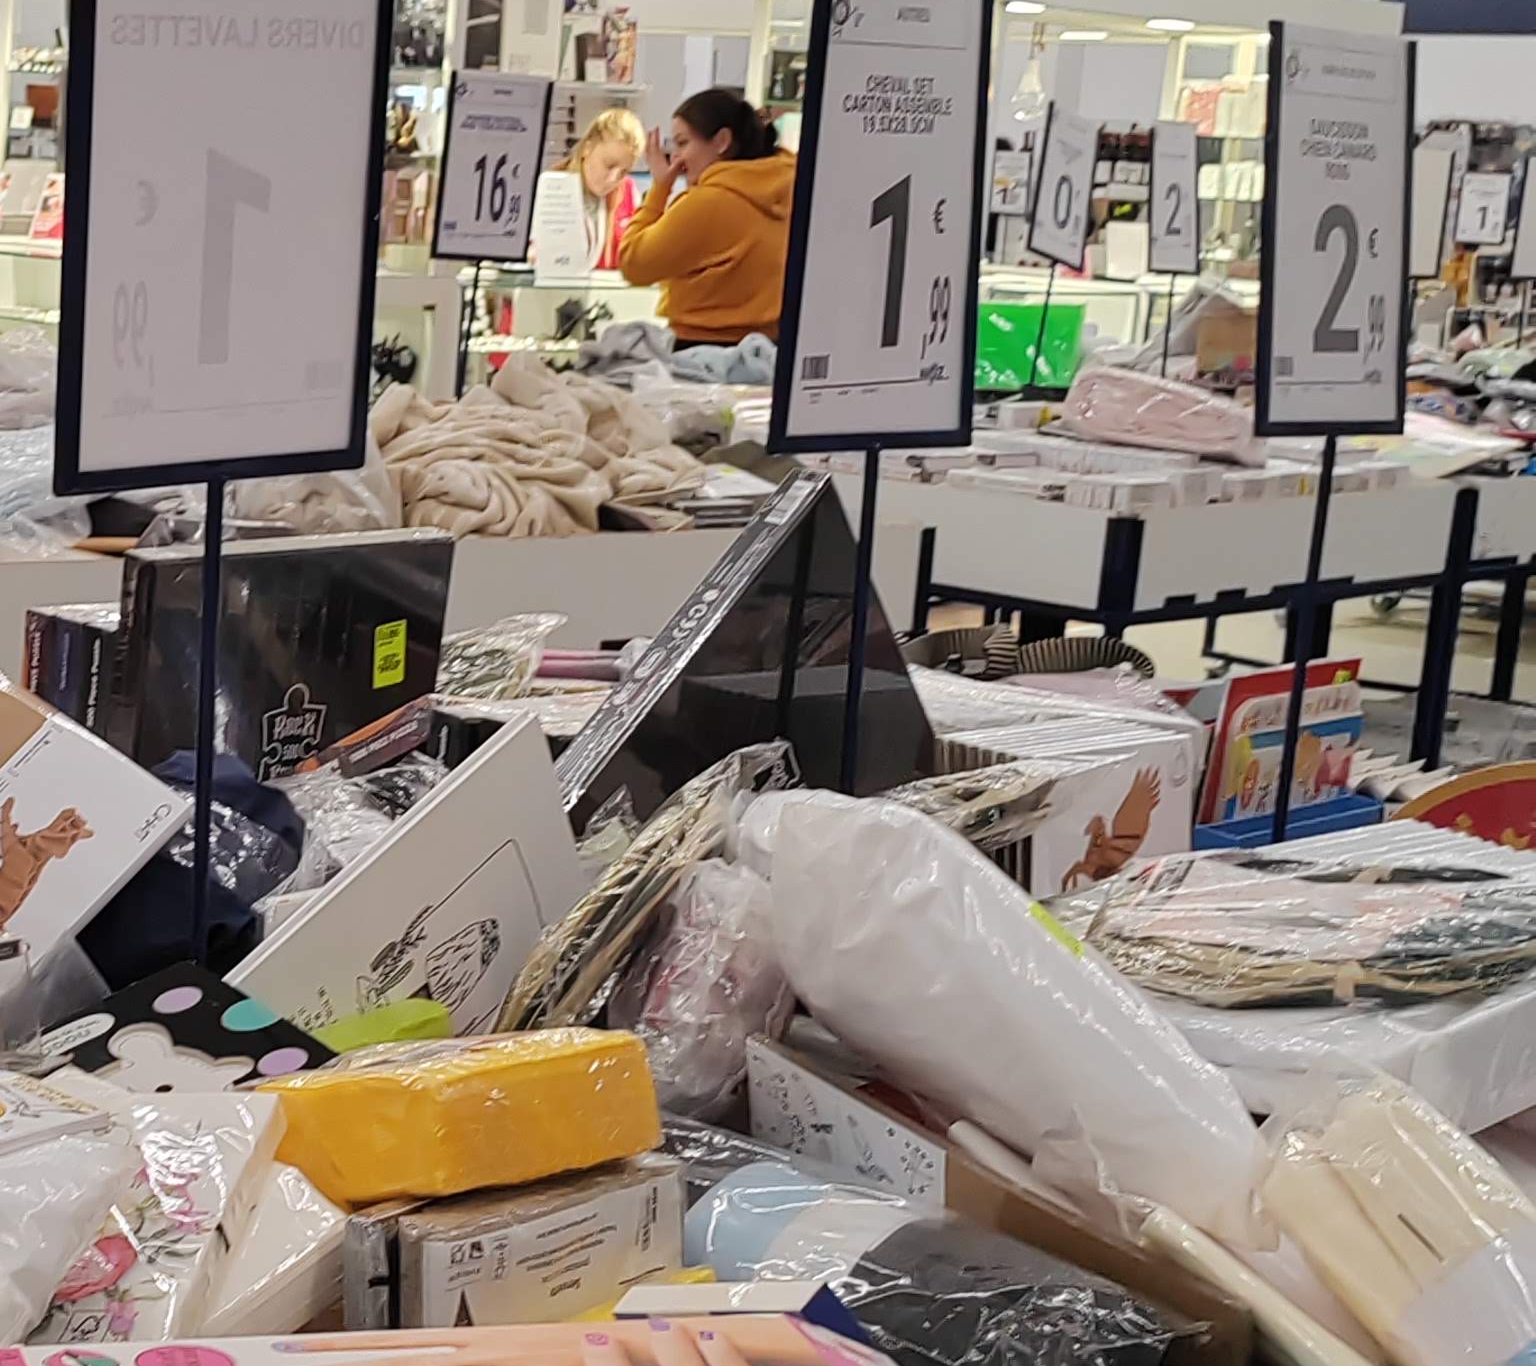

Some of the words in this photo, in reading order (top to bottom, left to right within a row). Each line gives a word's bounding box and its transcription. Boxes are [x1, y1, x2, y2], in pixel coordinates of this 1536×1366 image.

[473, 151, 509, 223] 16
[1054, 174, 1073, 230] 0
[1164, 182, 1182, 236] 2
[870, 173, 912, 348] 1
[1313, 203, 1360, 354] 2
